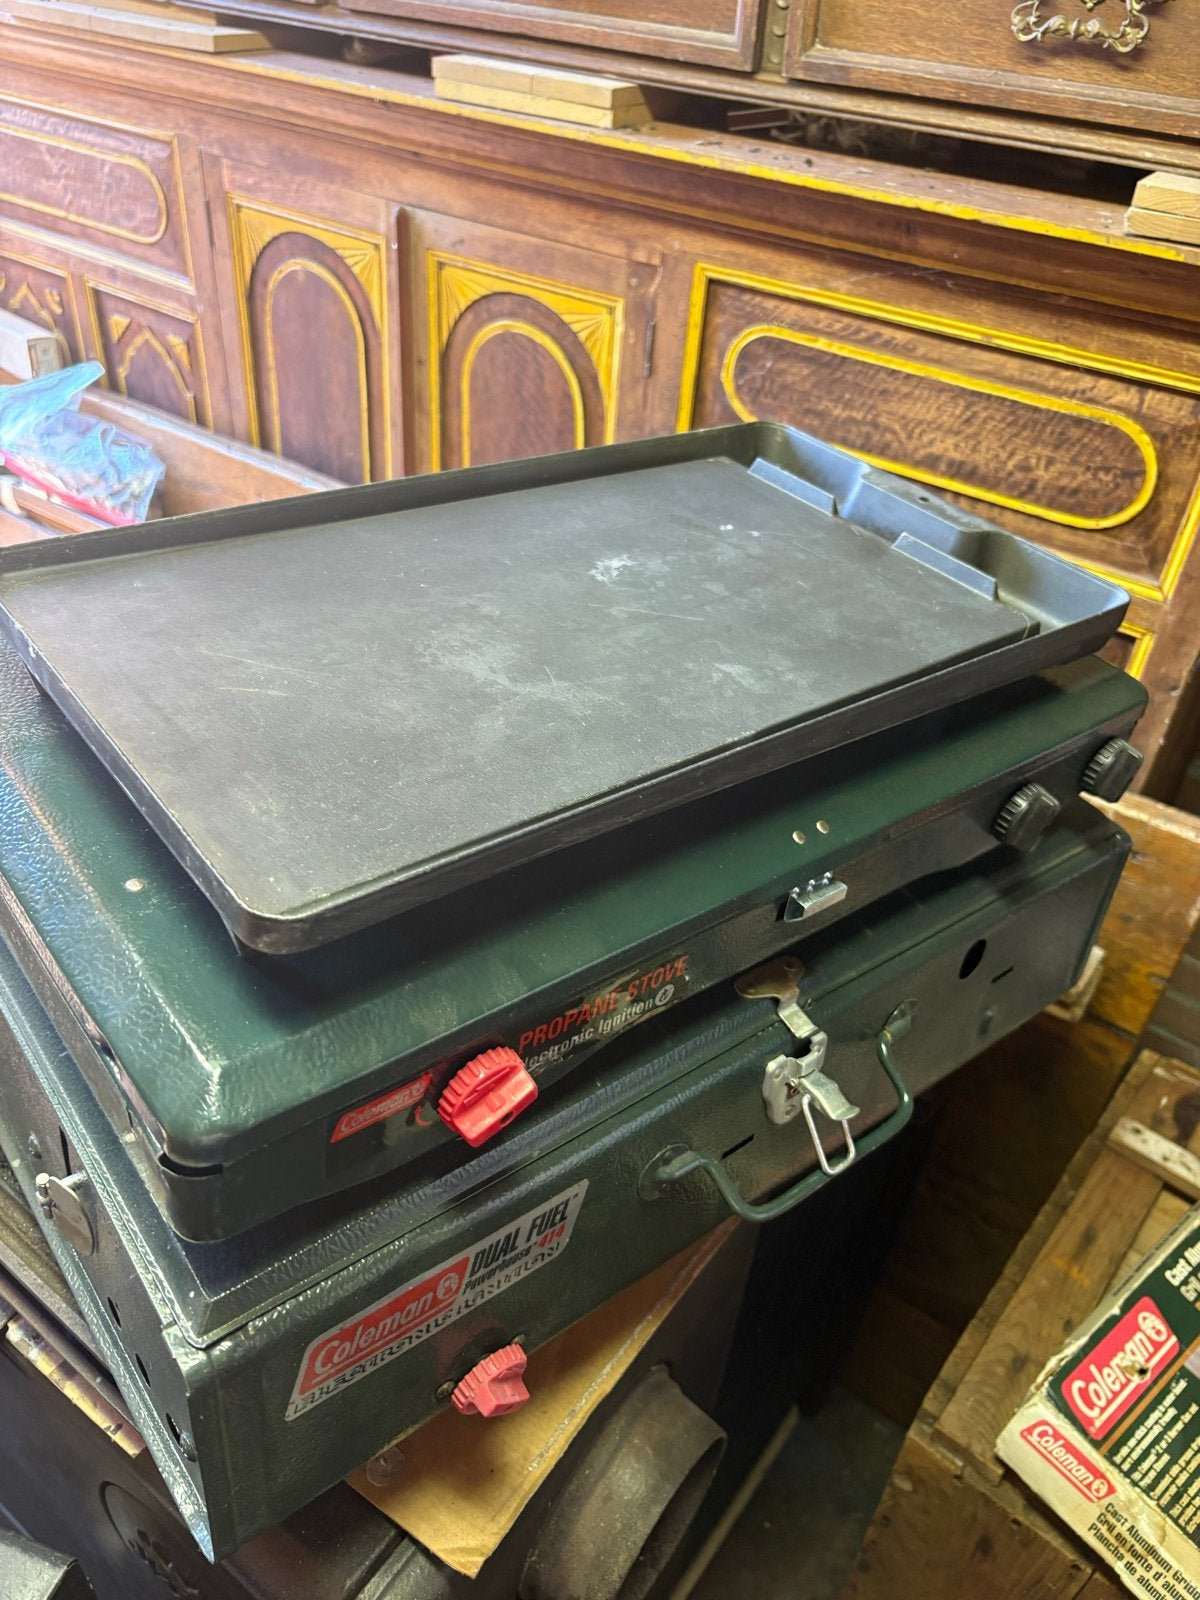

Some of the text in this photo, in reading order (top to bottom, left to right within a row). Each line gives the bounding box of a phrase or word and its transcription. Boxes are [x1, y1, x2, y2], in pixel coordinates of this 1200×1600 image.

[518, 955, 689, 1055] PROPANE STOVE
[522, 998, 654, 1067] lectronic Ignition
[468, 1226, 521, 1278] DUAL
[538, 1222, 566, 1248] 414
[1164, 1257, 1193, 1287] Cast
[314, 1291, 434, 1374] Coleman
[1031, 1424, 1095, 1486] Coleman
[1088, 1522, 1125, 1561] Plancha
[1124, 1560, 1137, 1576] de
[1096, 1512, 1116, 1534] Gril
[1114, 1532, 1127, 1548] en
[1127, 1544, 1153, 1572] fonte
[1105, 1503, 1128, 1526] Cast
[1126, 1524, 1173, 1573] Aluminum
